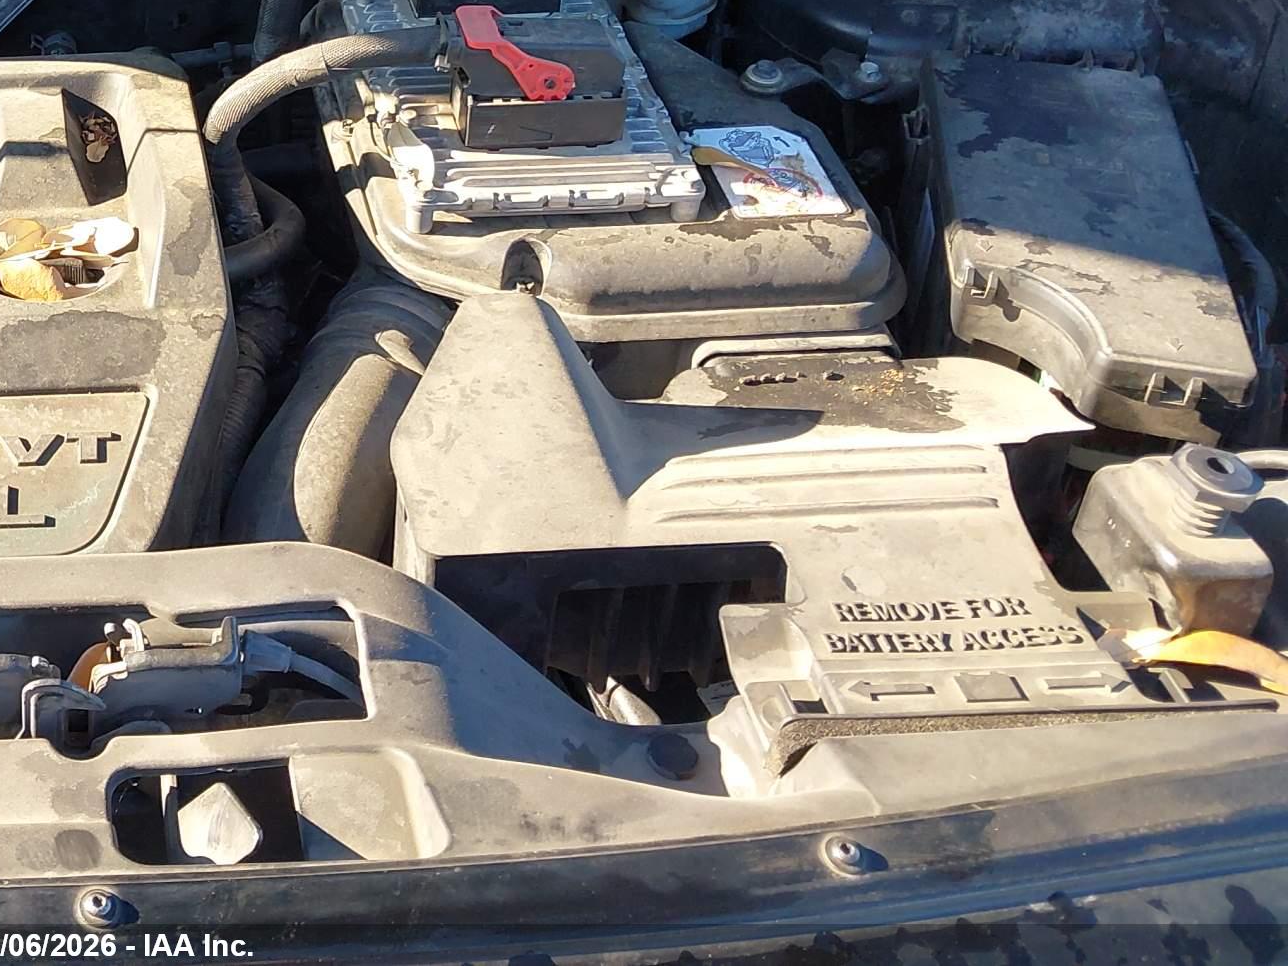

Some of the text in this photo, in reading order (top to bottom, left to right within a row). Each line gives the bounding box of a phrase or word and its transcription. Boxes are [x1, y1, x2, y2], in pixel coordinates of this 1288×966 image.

[832, 596, 1032, 622] REMOVE FOR
[824, 626, 1085, 654] BATTERY ACCESS
